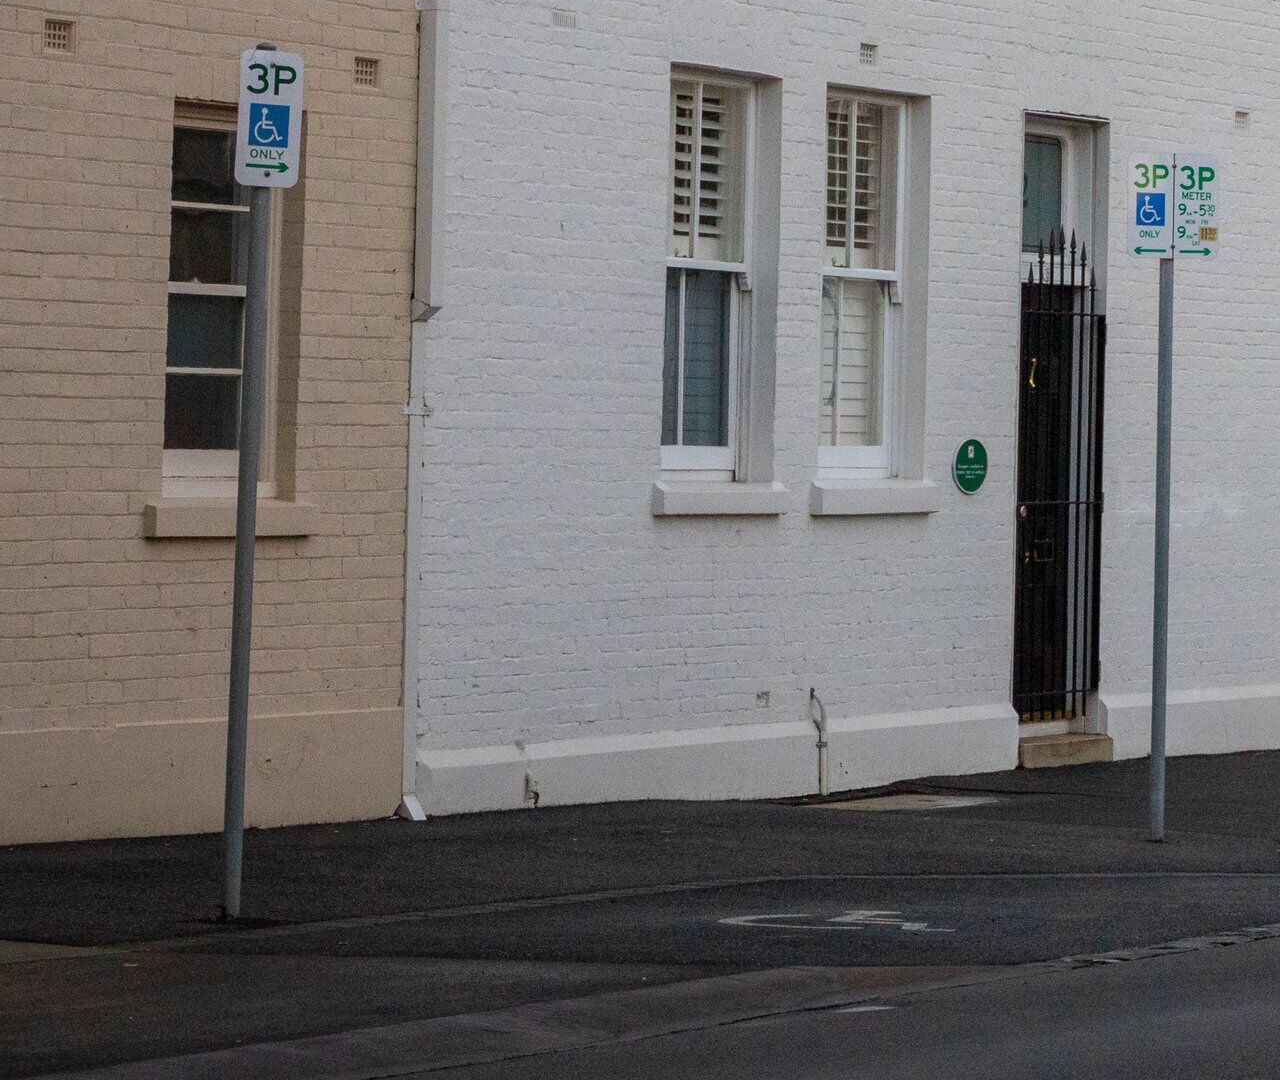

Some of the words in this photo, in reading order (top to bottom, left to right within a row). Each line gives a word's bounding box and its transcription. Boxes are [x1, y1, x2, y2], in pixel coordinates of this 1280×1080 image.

[246, 63, 297, 95] 3P
[249, 148, 285, 160] ONLY
[1134, 163, 1169, 188] 3P
[1180, 165, 1216, 191] 3P
[1182, 192, 1212, 200] METER
[1139, 229, 1160, 238] ONLY
